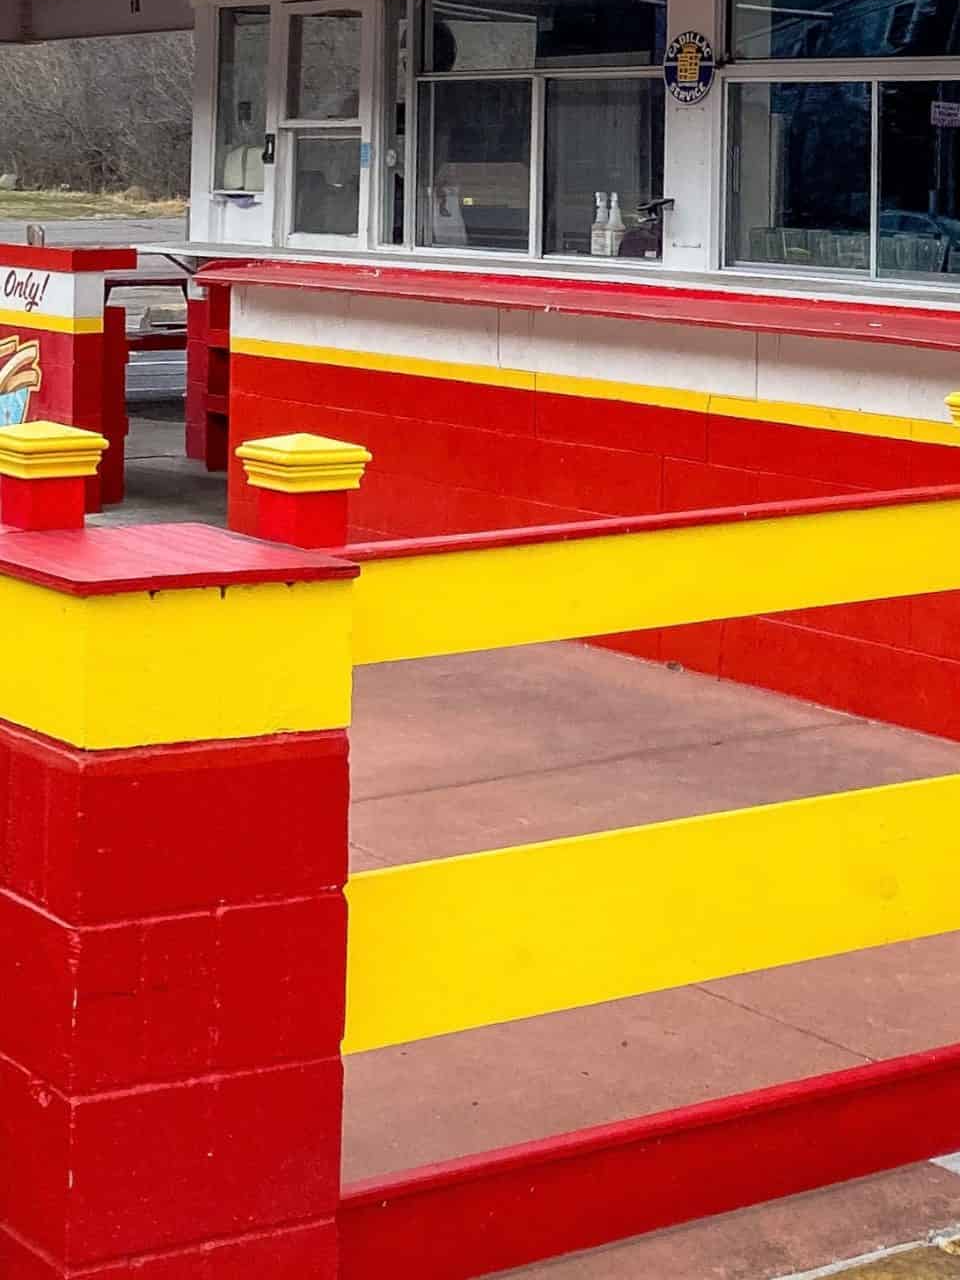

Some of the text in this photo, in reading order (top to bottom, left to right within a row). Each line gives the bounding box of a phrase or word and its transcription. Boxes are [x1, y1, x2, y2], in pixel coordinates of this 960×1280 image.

[667, 32, 712, 58] CADILLAC
[670, 82, 706, 101] SERVICE
[4, 270, 50, 312] Only!
